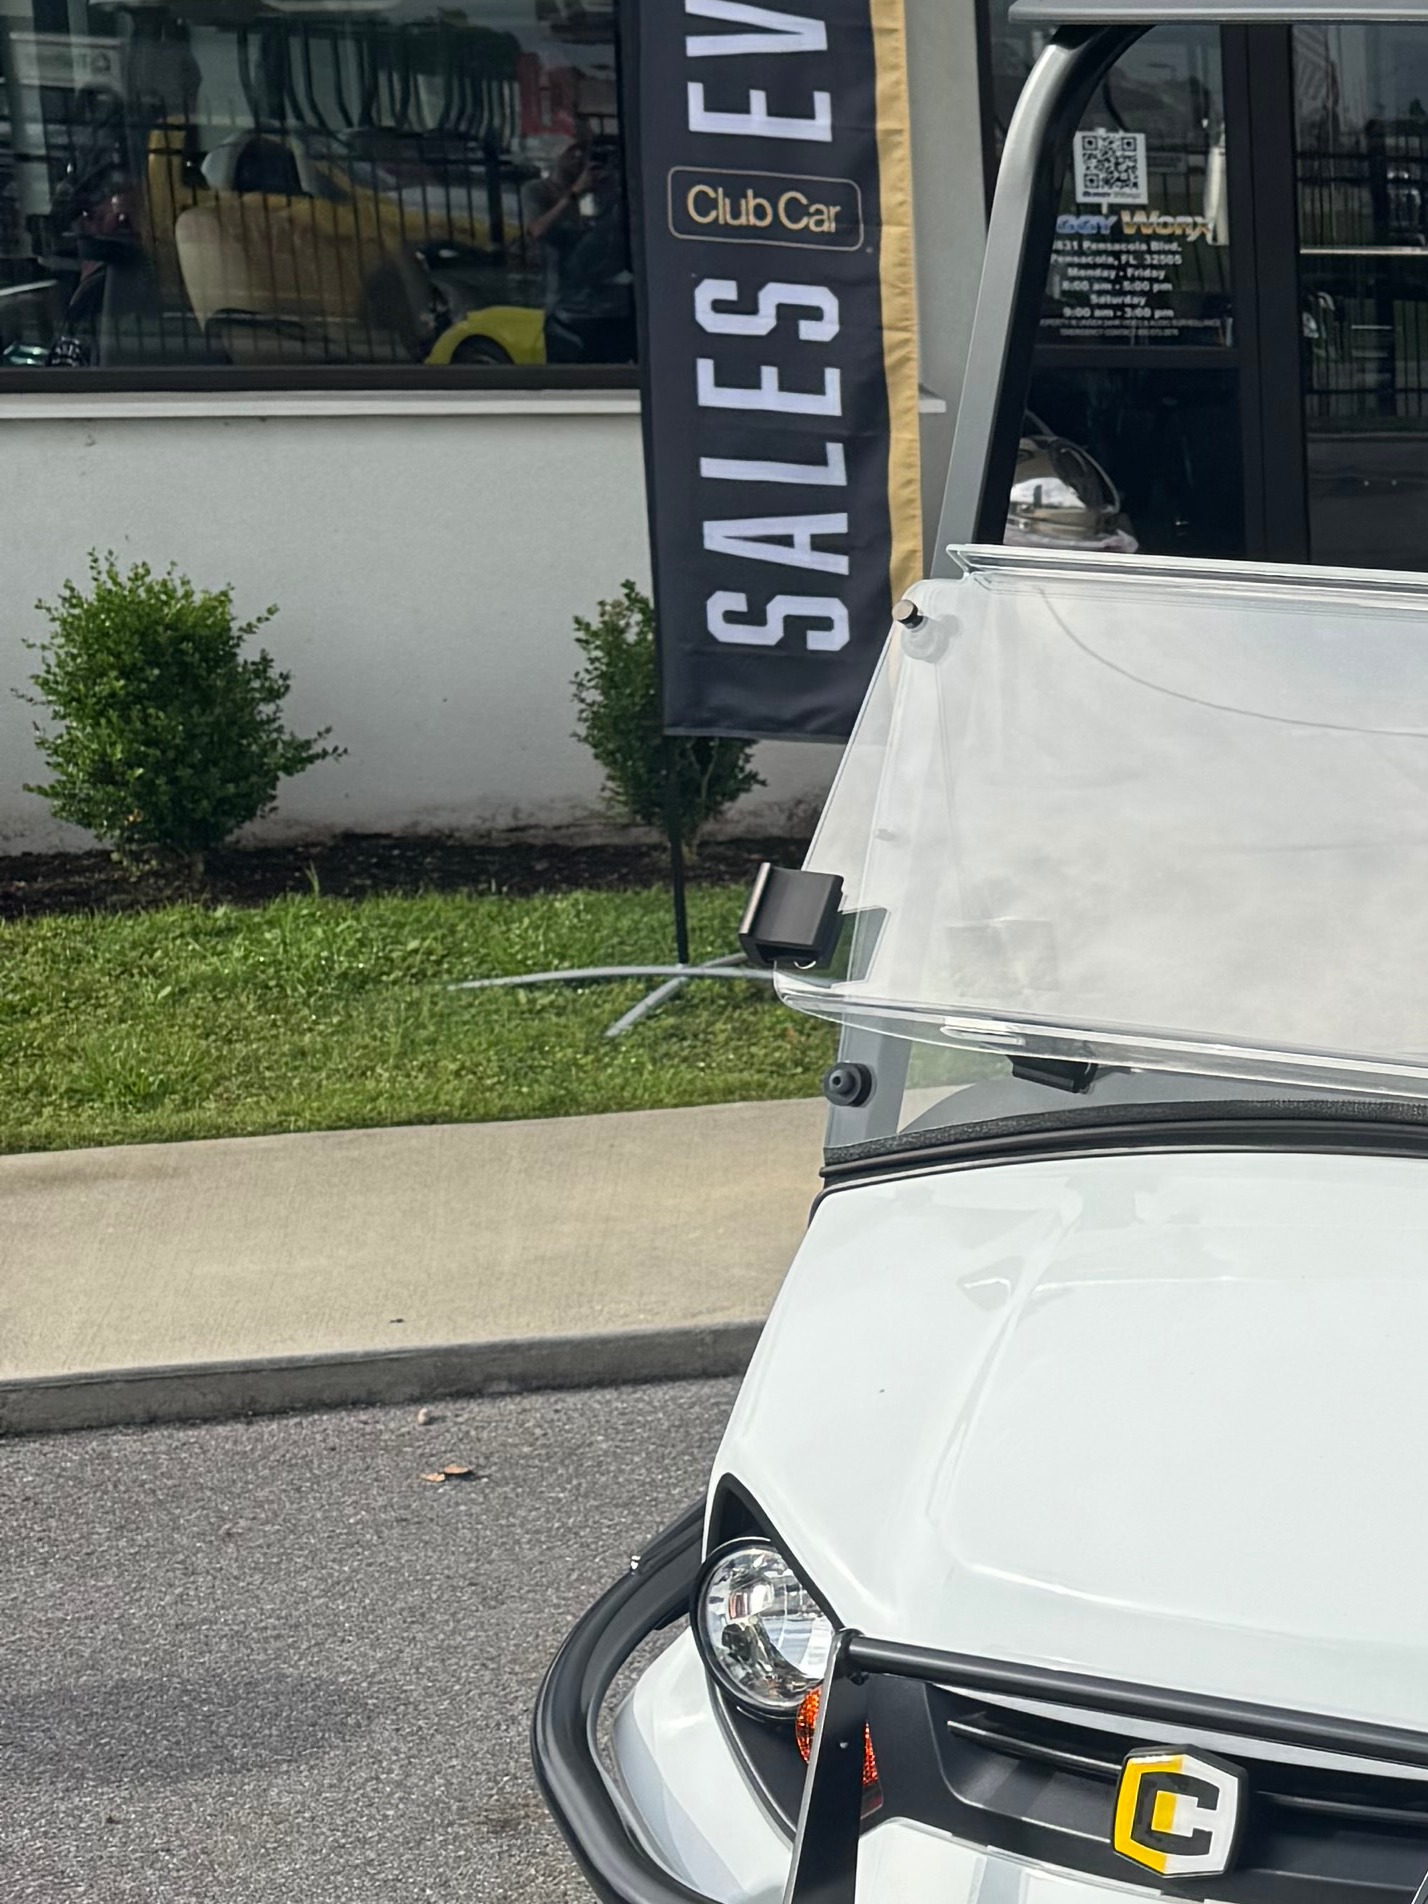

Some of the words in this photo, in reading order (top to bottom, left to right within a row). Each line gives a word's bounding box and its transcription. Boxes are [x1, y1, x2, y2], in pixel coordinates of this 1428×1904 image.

[687, 184, 773, 227] Club
[778, 190, 841, 233] Car
[1083, 241, 1148, 253] Pensacola
[1067, 267, 1117, 280] Monday
[1127, 267, 1166, 280] Friday
[1090, 294, 1147, 307] Saturday
[693, 276, 851, 654] SALES
